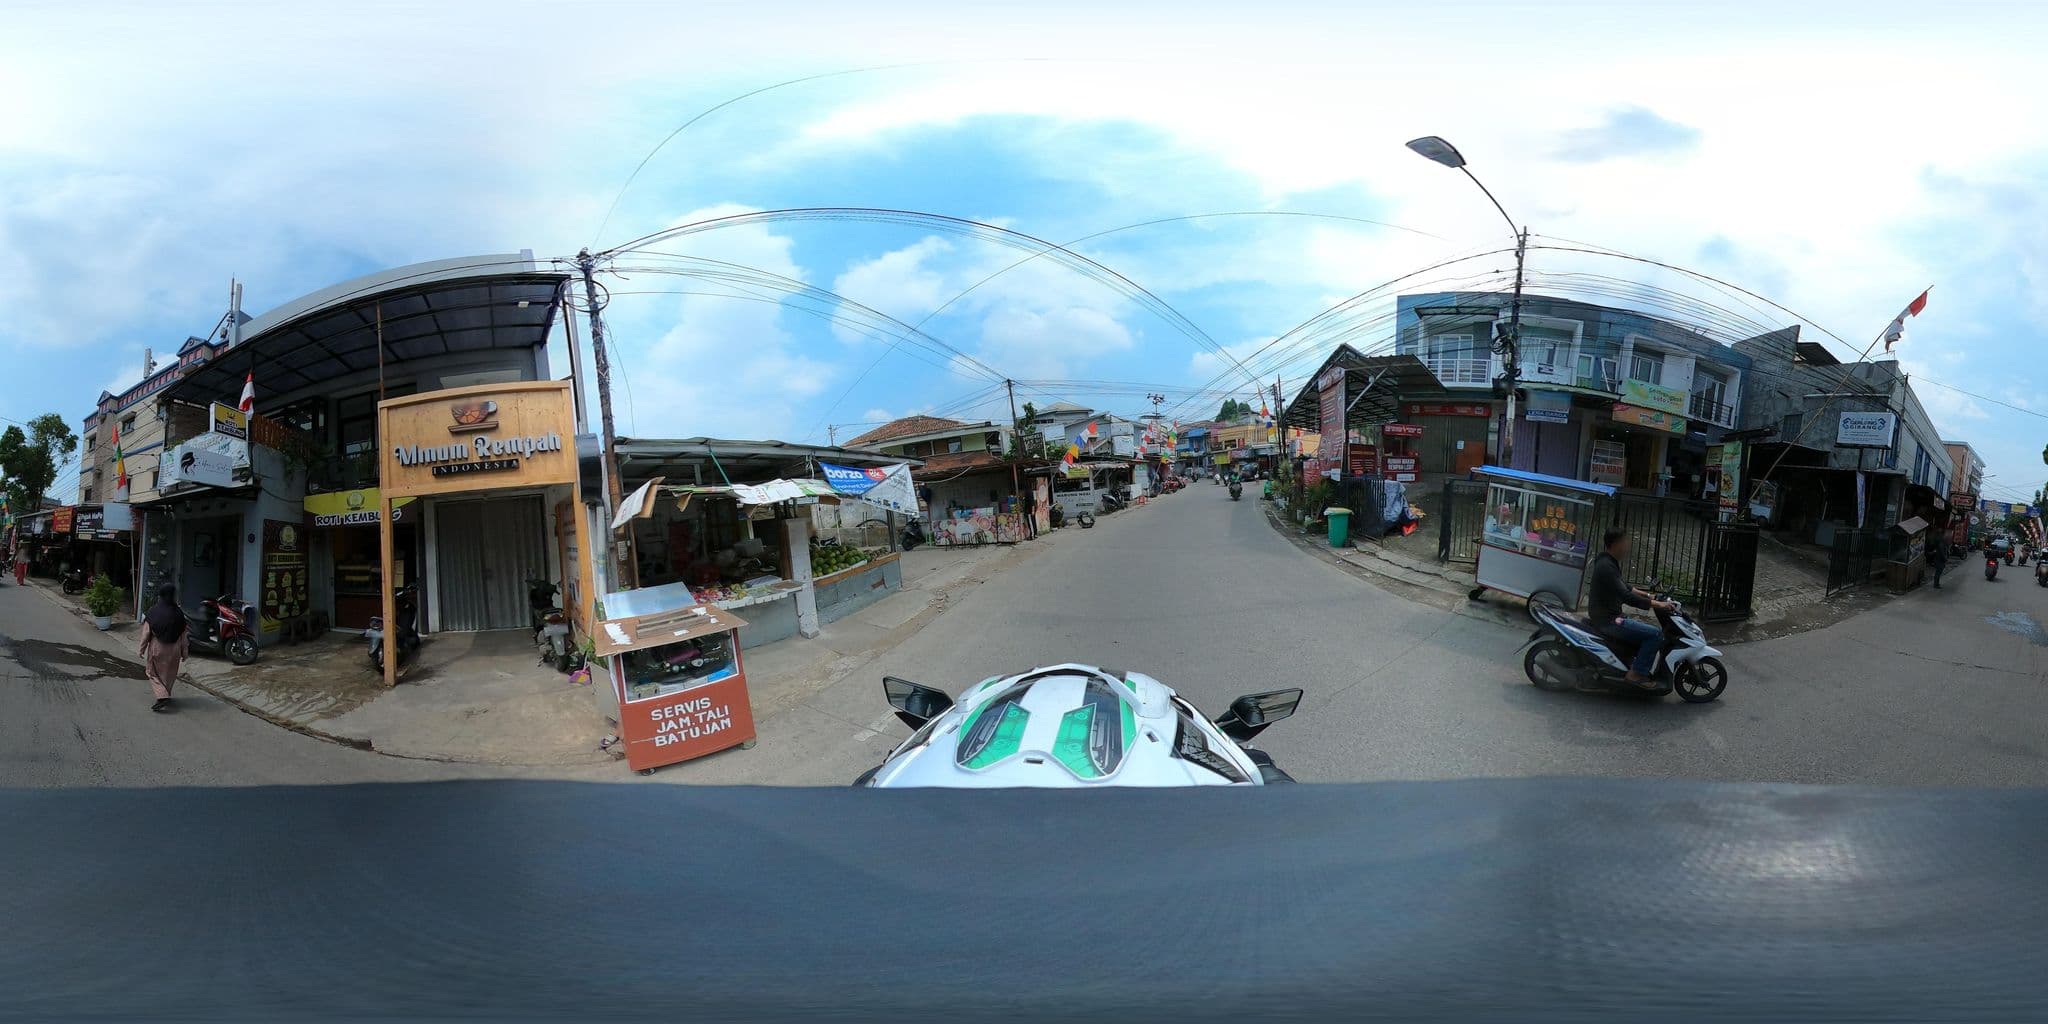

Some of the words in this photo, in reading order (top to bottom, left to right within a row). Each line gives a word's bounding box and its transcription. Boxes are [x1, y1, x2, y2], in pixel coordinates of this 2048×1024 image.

[474, 431, 560, 459] Rempah
[433, 460, 518, 474] INDONESIA
[315, 514, 341, 526] ROTI
[343, 508, 402, 524] KEMBUG
[651, 697, 711, 721] SERVIS
[695, 705, 729, 724] TALI
